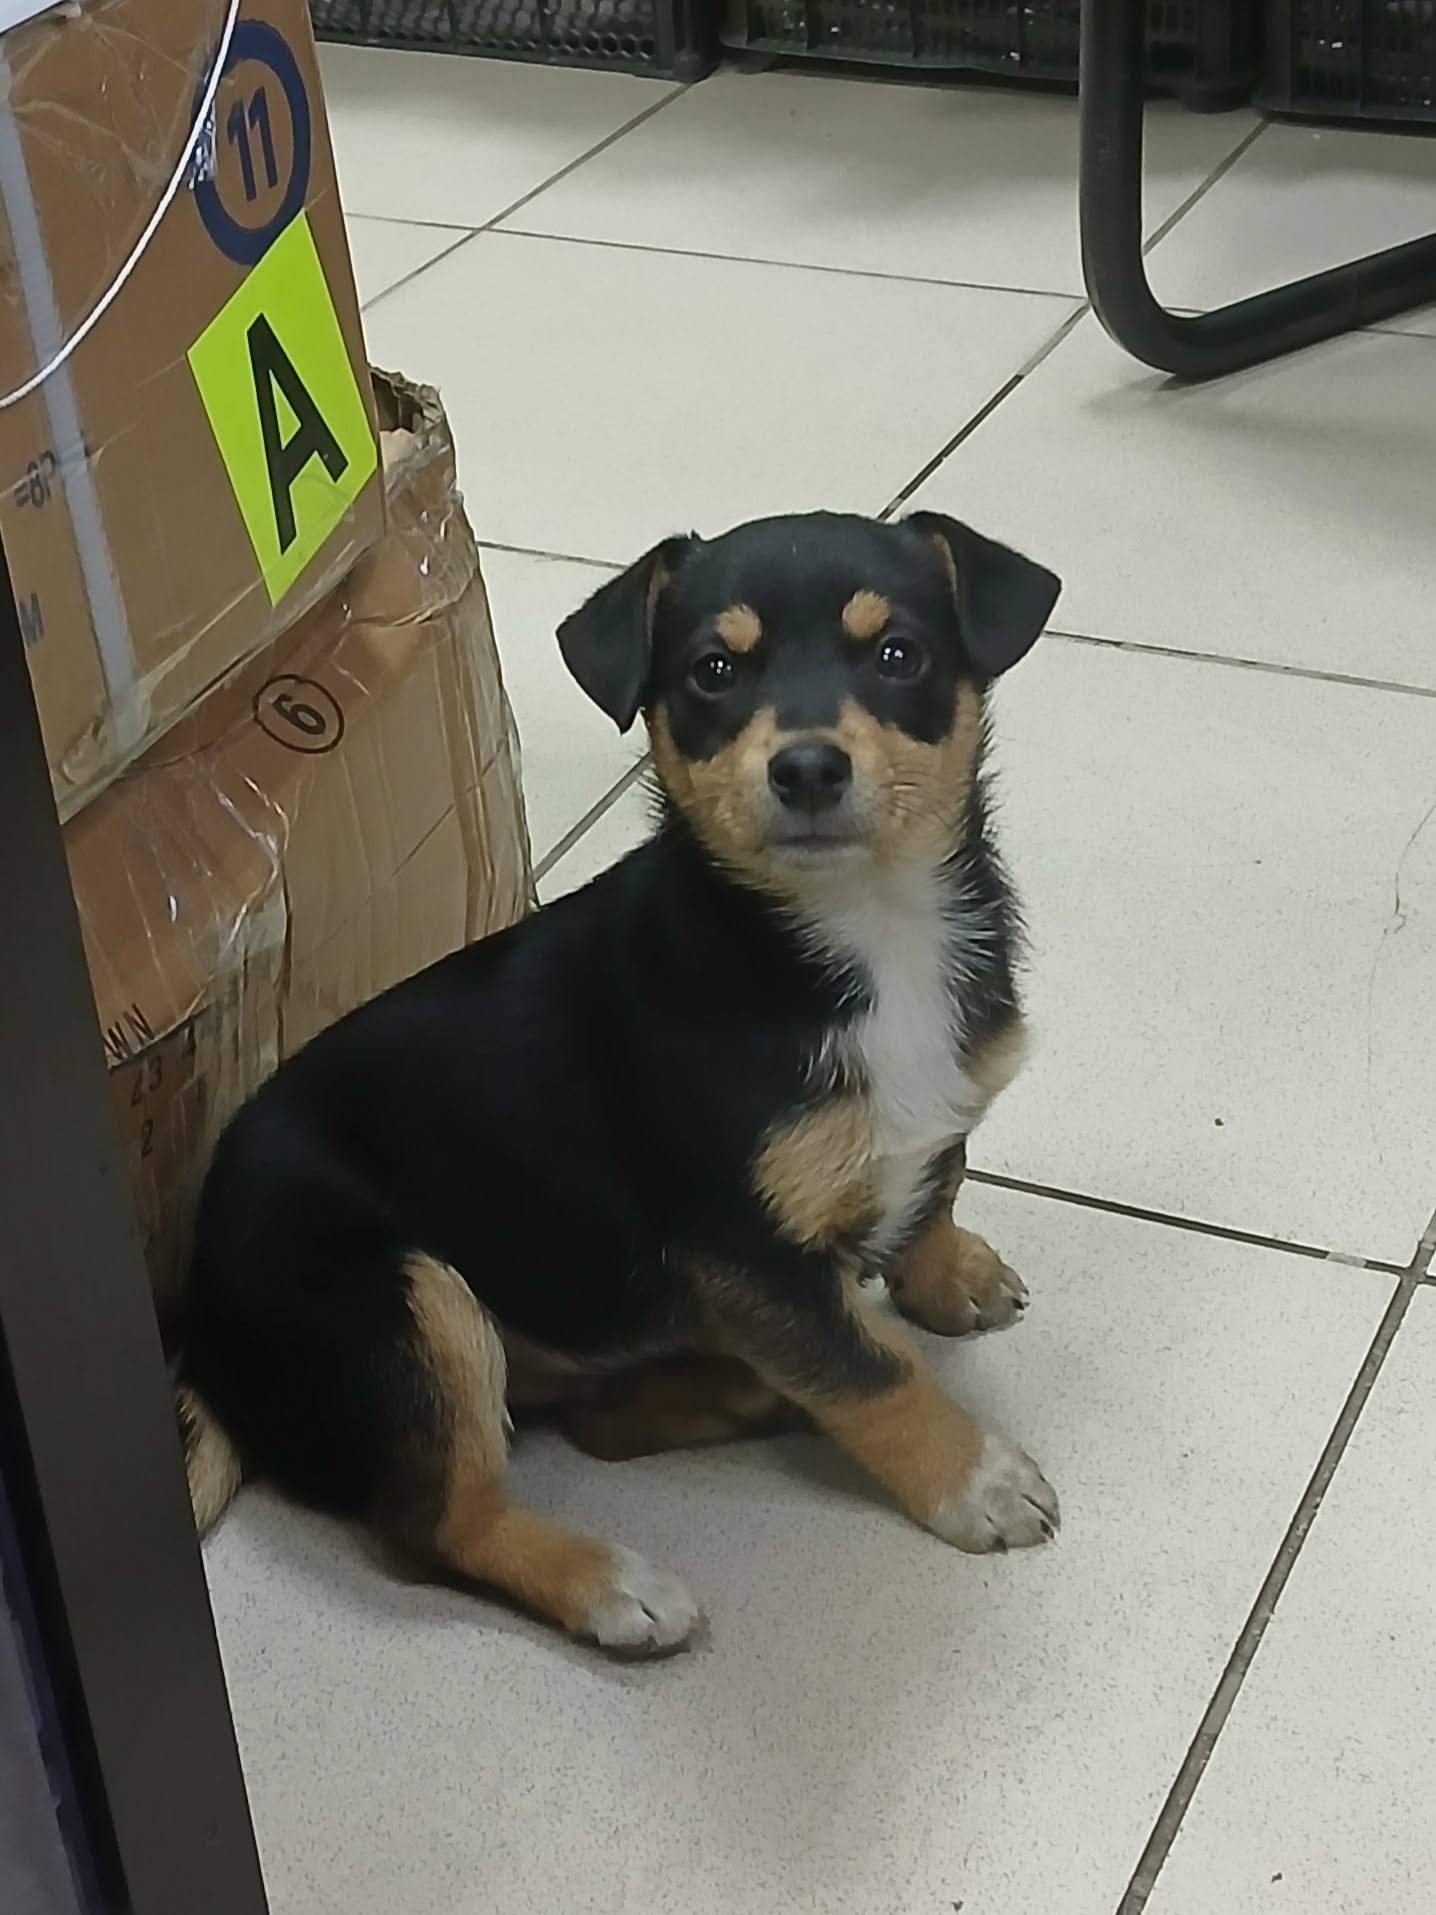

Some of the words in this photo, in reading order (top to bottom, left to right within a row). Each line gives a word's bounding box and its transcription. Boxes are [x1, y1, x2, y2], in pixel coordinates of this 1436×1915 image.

[227, 86, 278, 202] 11
[246, 312, 348, 556] A
[272, 694, 326, 735] 6
